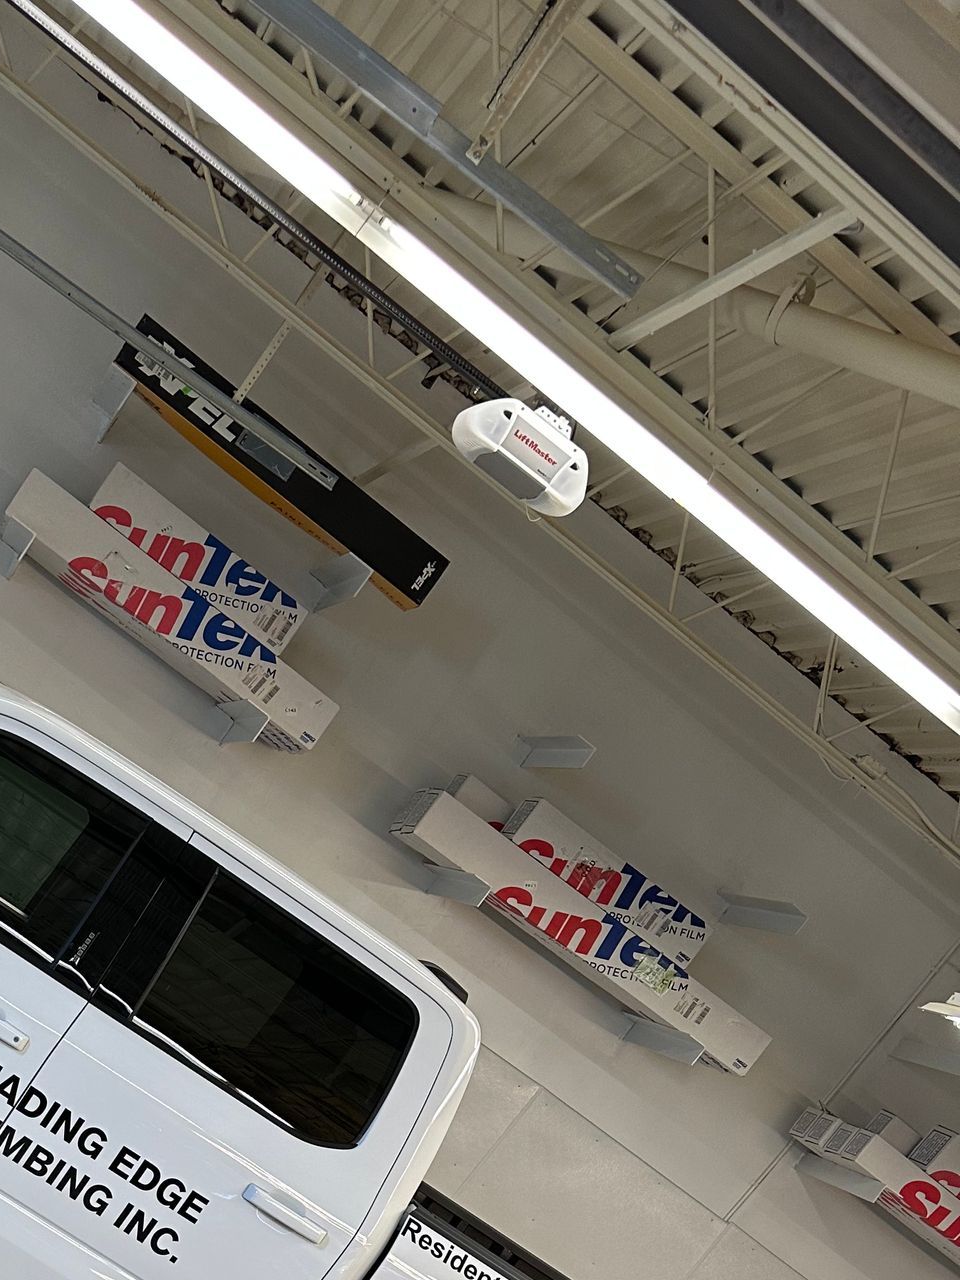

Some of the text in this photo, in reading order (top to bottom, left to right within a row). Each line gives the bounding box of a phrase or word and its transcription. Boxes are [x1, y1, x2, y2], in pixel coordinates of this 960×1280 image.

[513, 429, 558, 466] LiftMaster
[194, 587, 267, 614] PROTECTIO
[246, 663, 278, 680] FM
[679, 927, 707, 942] FILM
[107, 1144, 210, 1226] EDGE
[113, 1201, 179, 1264] INC.
